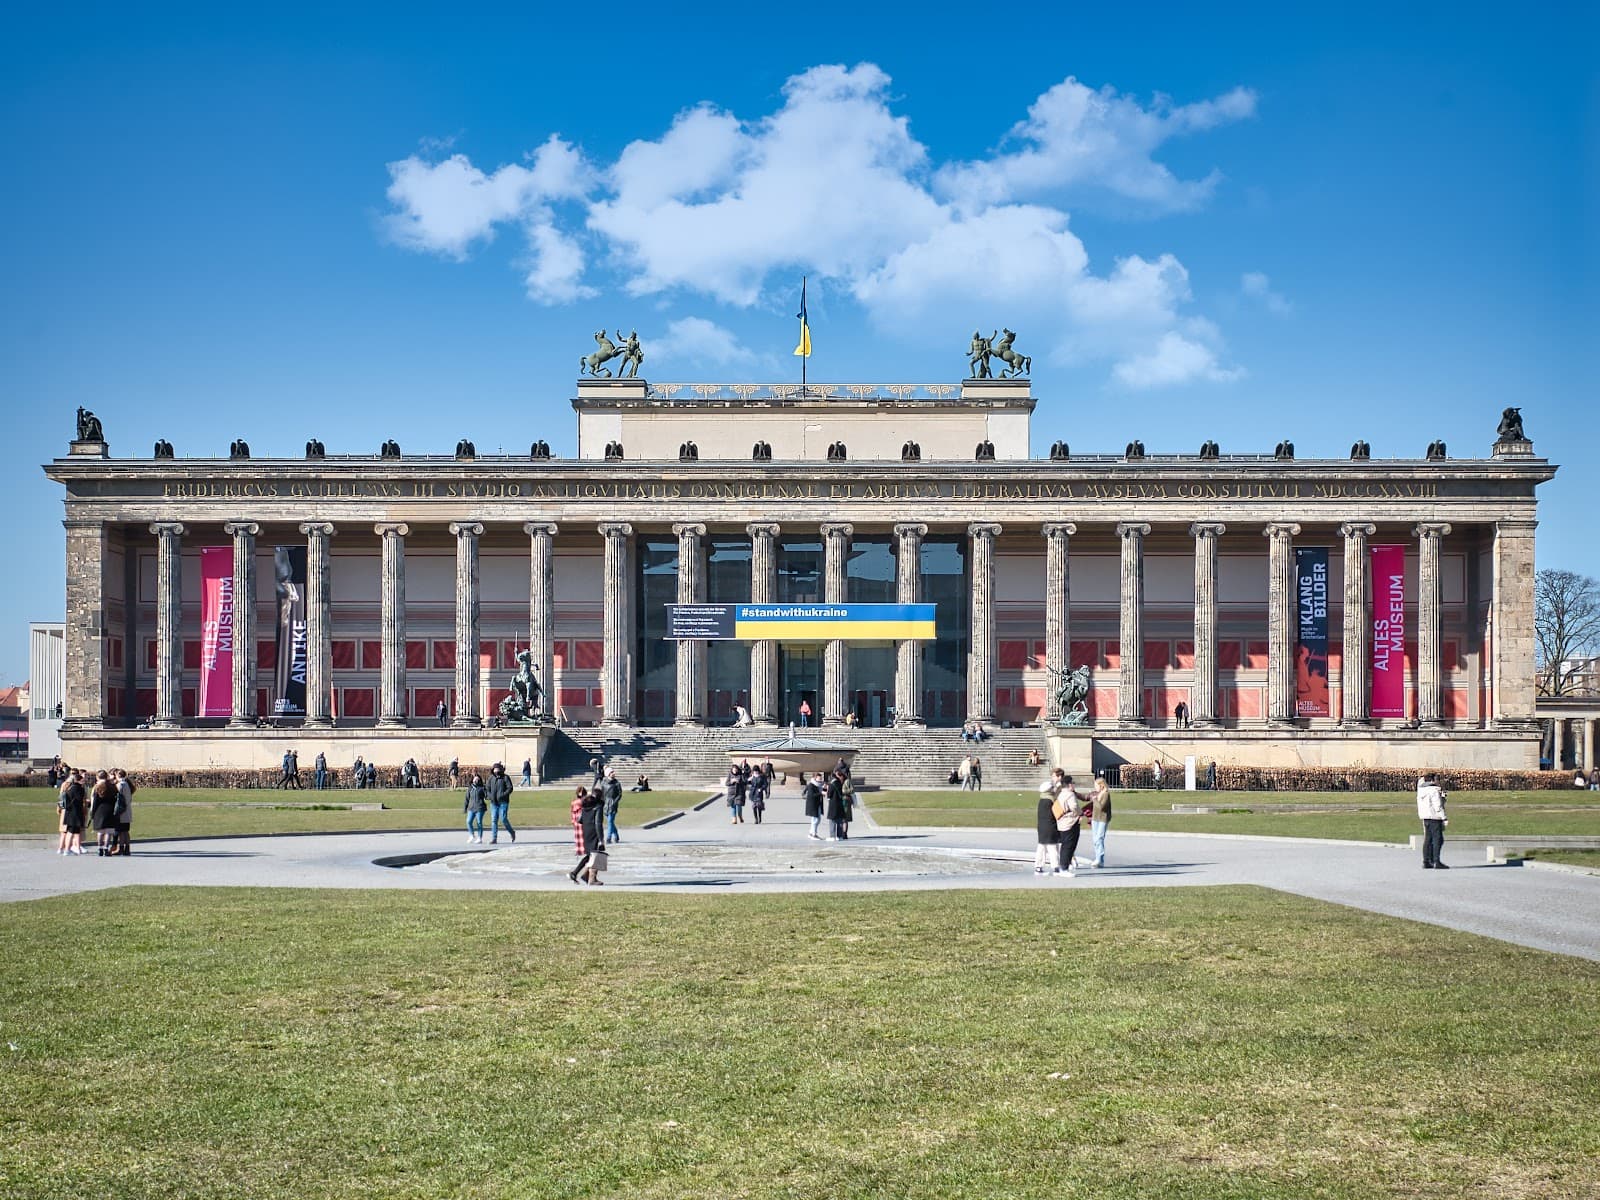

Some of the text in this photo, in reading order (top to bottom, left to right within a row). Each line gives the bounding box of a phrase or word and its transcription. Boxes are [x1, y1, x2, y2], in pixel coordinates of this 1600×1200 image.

[830, 484, 855, 498] ET
[951, 484, 1073, 498] LIBERALIVM
[1084, 484, 1169, 498] MVSEVM
[219, 576, 232, 652] MUSEUM
[741, 607, 848, 618] #standwithukraine
[1300, 576, 1313, 625] KLANG
[1313, 563, 1327, 618] BILDER
[1390, 575, 1404, 651] MUSEUM
[204, 620, 218, 671] ALTES
[292, 620, 306, 684] ANTIKE
[1374, 619, 1389, 671] ALTES
